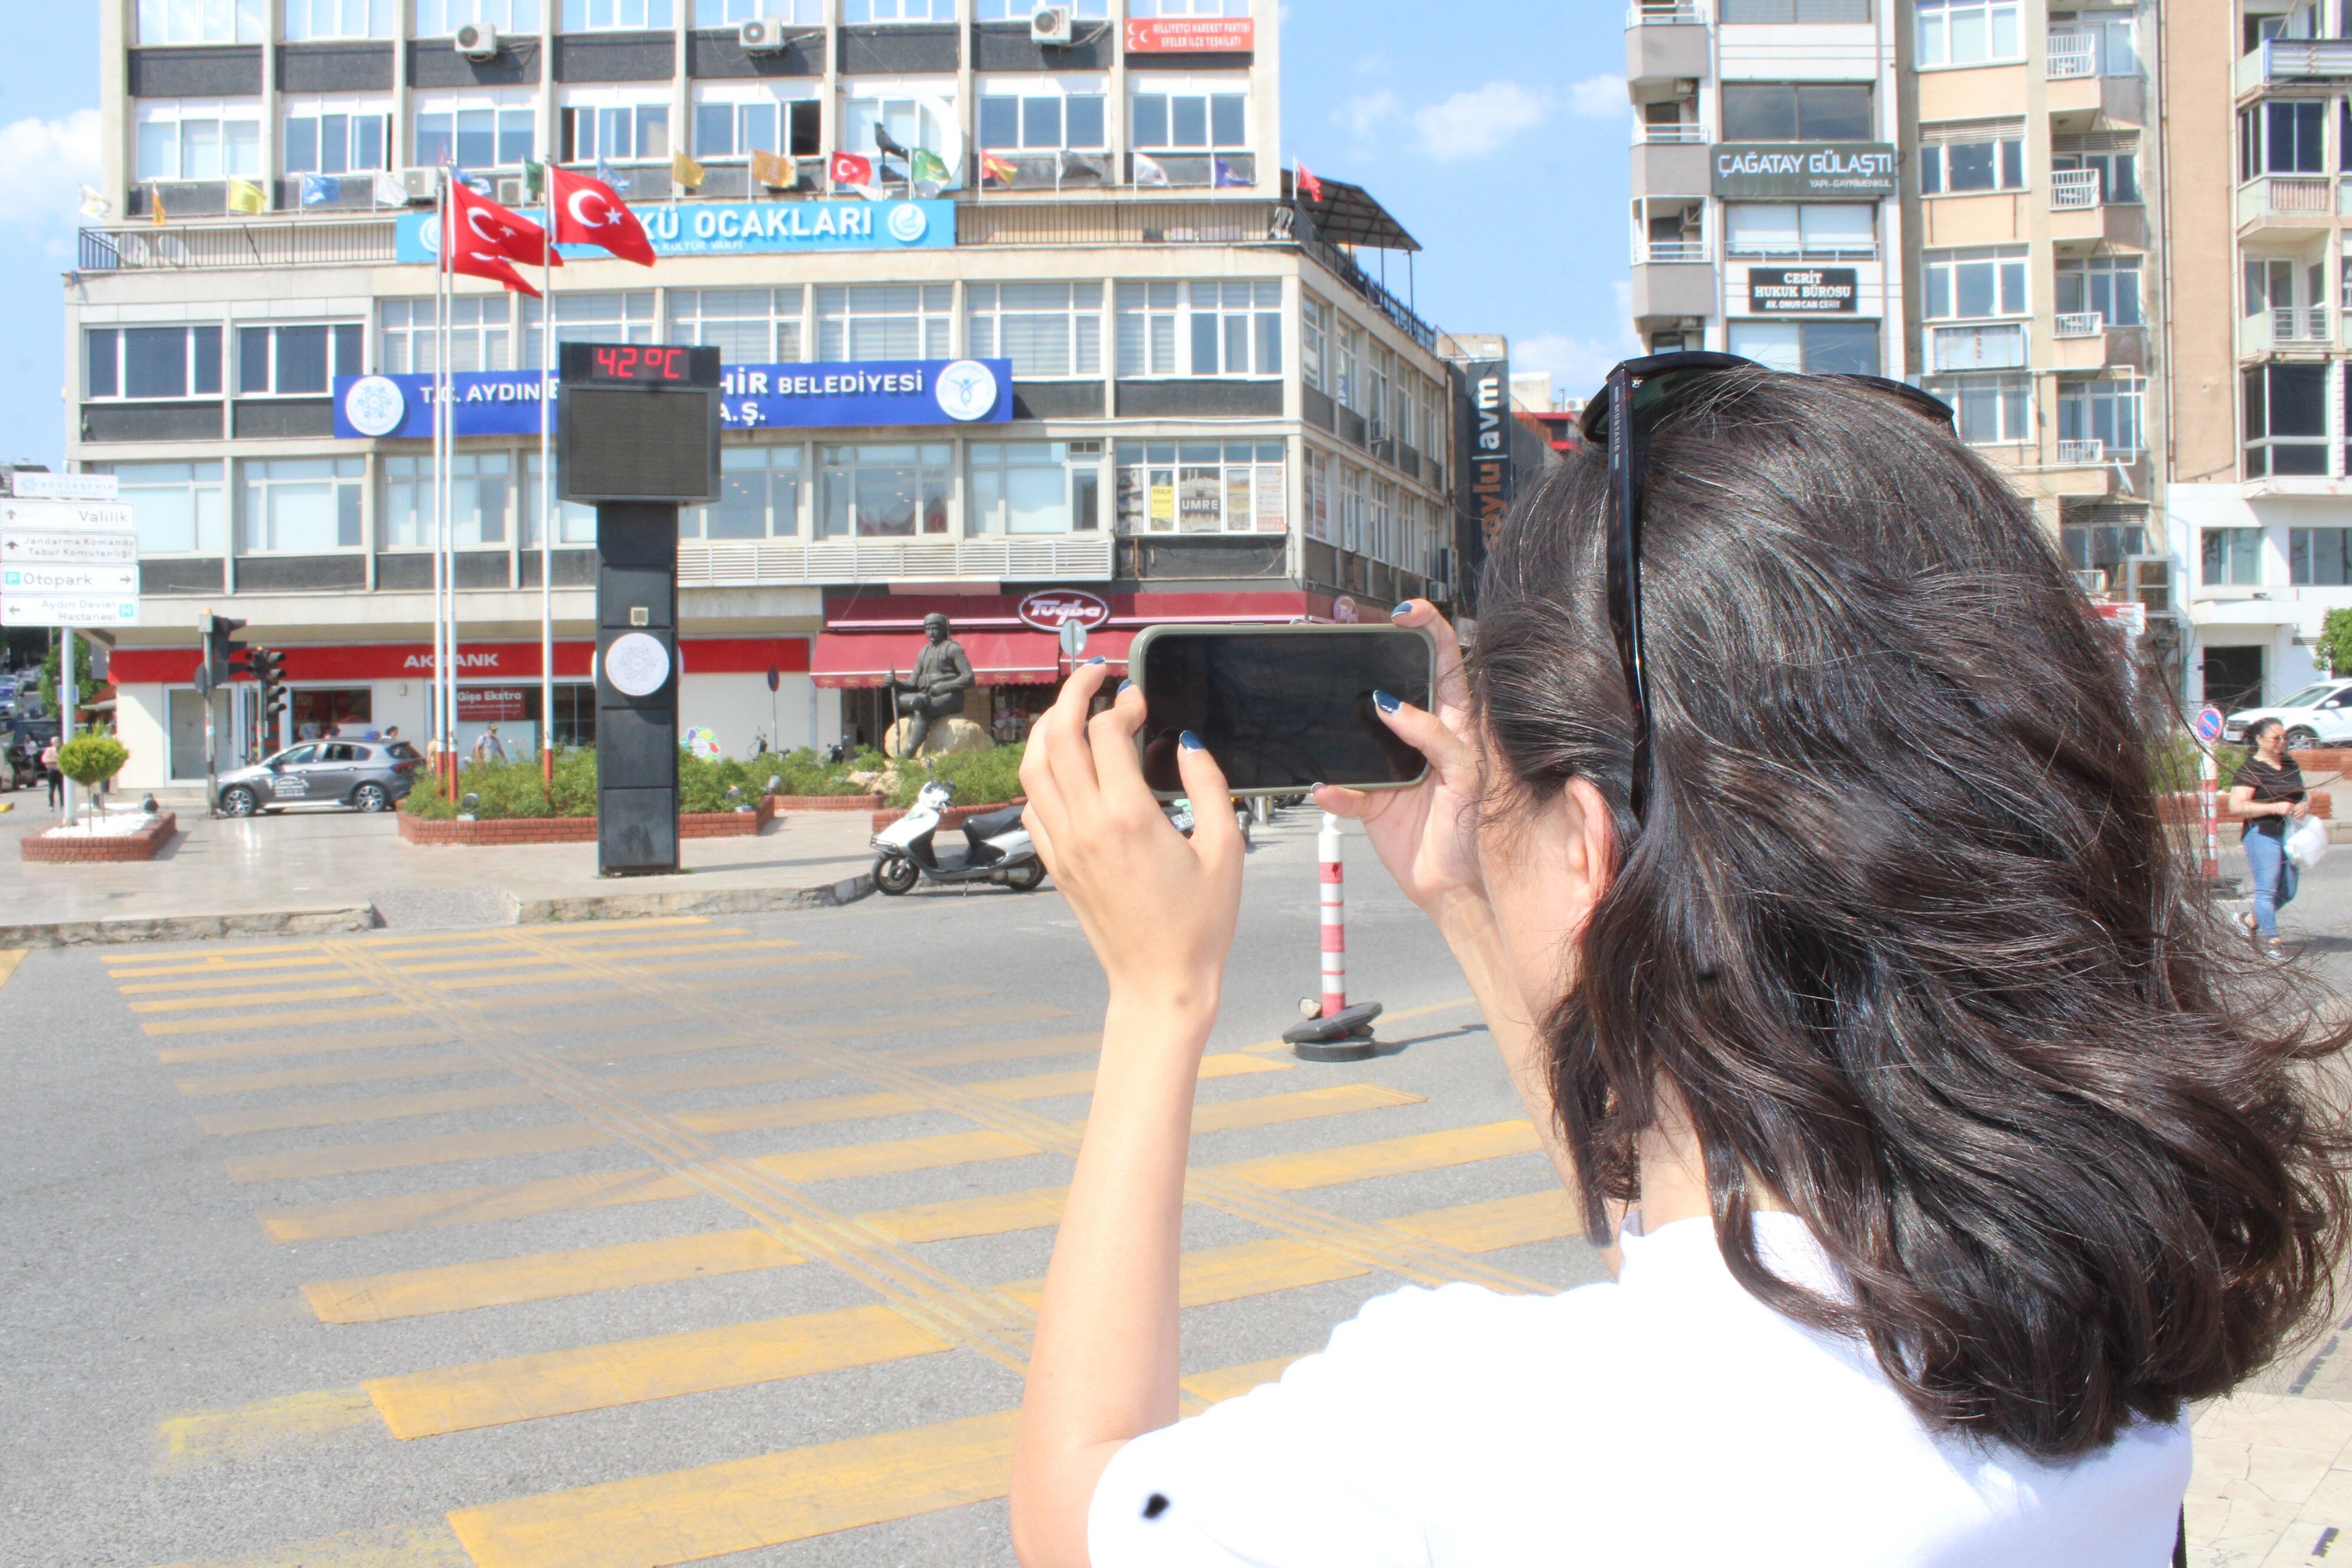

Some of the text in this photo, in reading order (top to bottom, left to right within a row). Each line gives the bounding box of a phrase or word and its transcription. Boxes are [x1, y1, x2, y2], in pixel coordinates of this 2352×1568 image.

[1192, 23, 1222, 34] HAREKET
[1161, 37, 1187, 47] EFELER
[1718, 150, 1892, 178] ÇAĞATAY GÜLAŞTI
[1809, 179, 1828, 188] YAPI
[694, 207, 871, 239] OCAKLARI
[662, 240, 705, 251] KÜLTÜR
[711, 240, 743, 250] VAKFI
[1783, 270, 1823, 285] CERİT
[1754, 284, 1851, 298] HUKUK BÜROSU
[466, 383, 540, 401] AYDIN
[778, 369, 923, 394] BELEDİYESİ
[1473, 377, 1510, 553] oylu avm
[1181, 499, 1219, 510] UMRE
[79, 510, 128, 523] Valilik
[24, 537, 135, 547] Jandarma Komando
[28, 547, 132, 558] Tabur Komutanlığı
[24, 572, 93, 589] Otopark
[79, 600, 116, 609] Devlet
[58, 612, 116, 622] Hastanesi
[403, 653, 499, 668] AKANK
[457, 690, 522, 704] Gişe Ekstra
